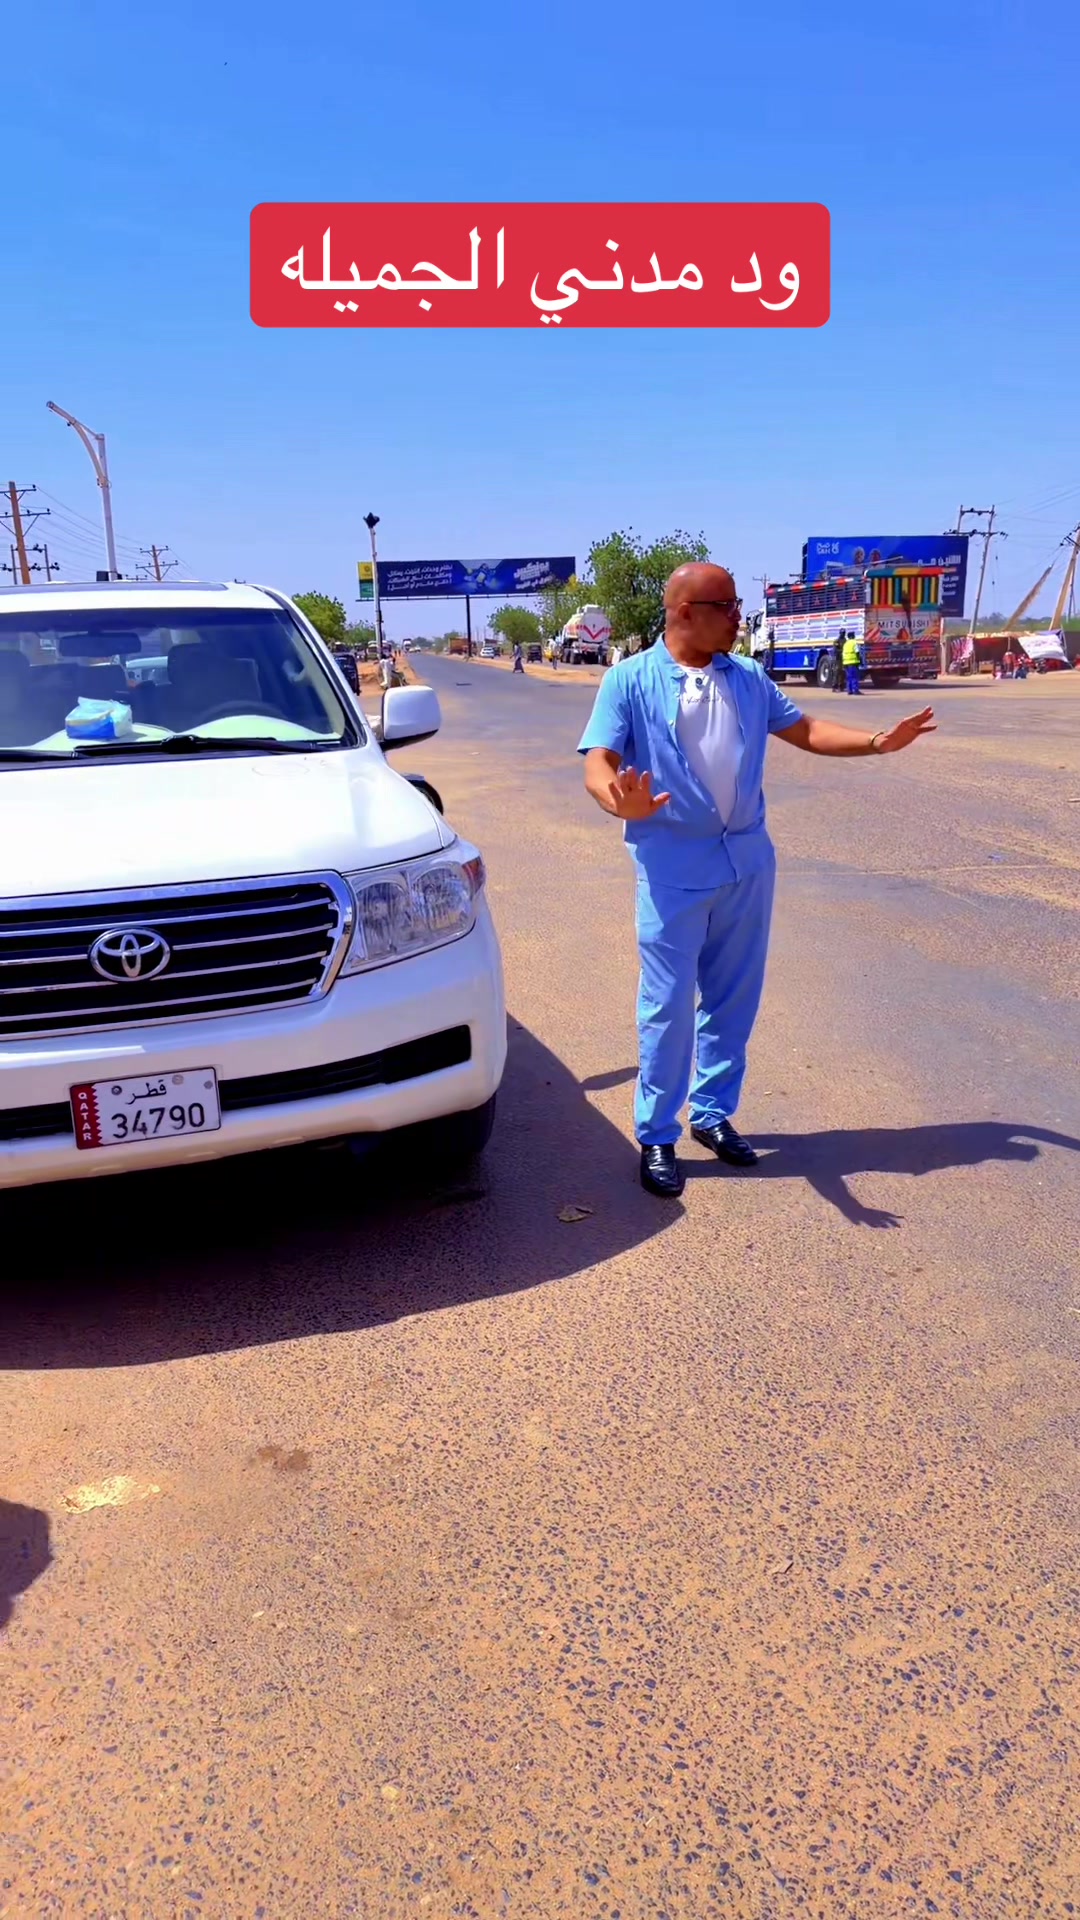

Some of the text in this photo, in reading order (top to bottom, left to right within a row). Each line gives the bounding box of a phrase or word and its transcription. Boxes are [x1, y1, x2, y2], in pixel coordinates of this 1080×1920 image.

[878, 620, 930, 629] MITSUISHI
[125, 1079, 168, 1105] قطر
[78, 1092, 93, 1141] QATAR
[111, 1102, 205, 1139] 34790
